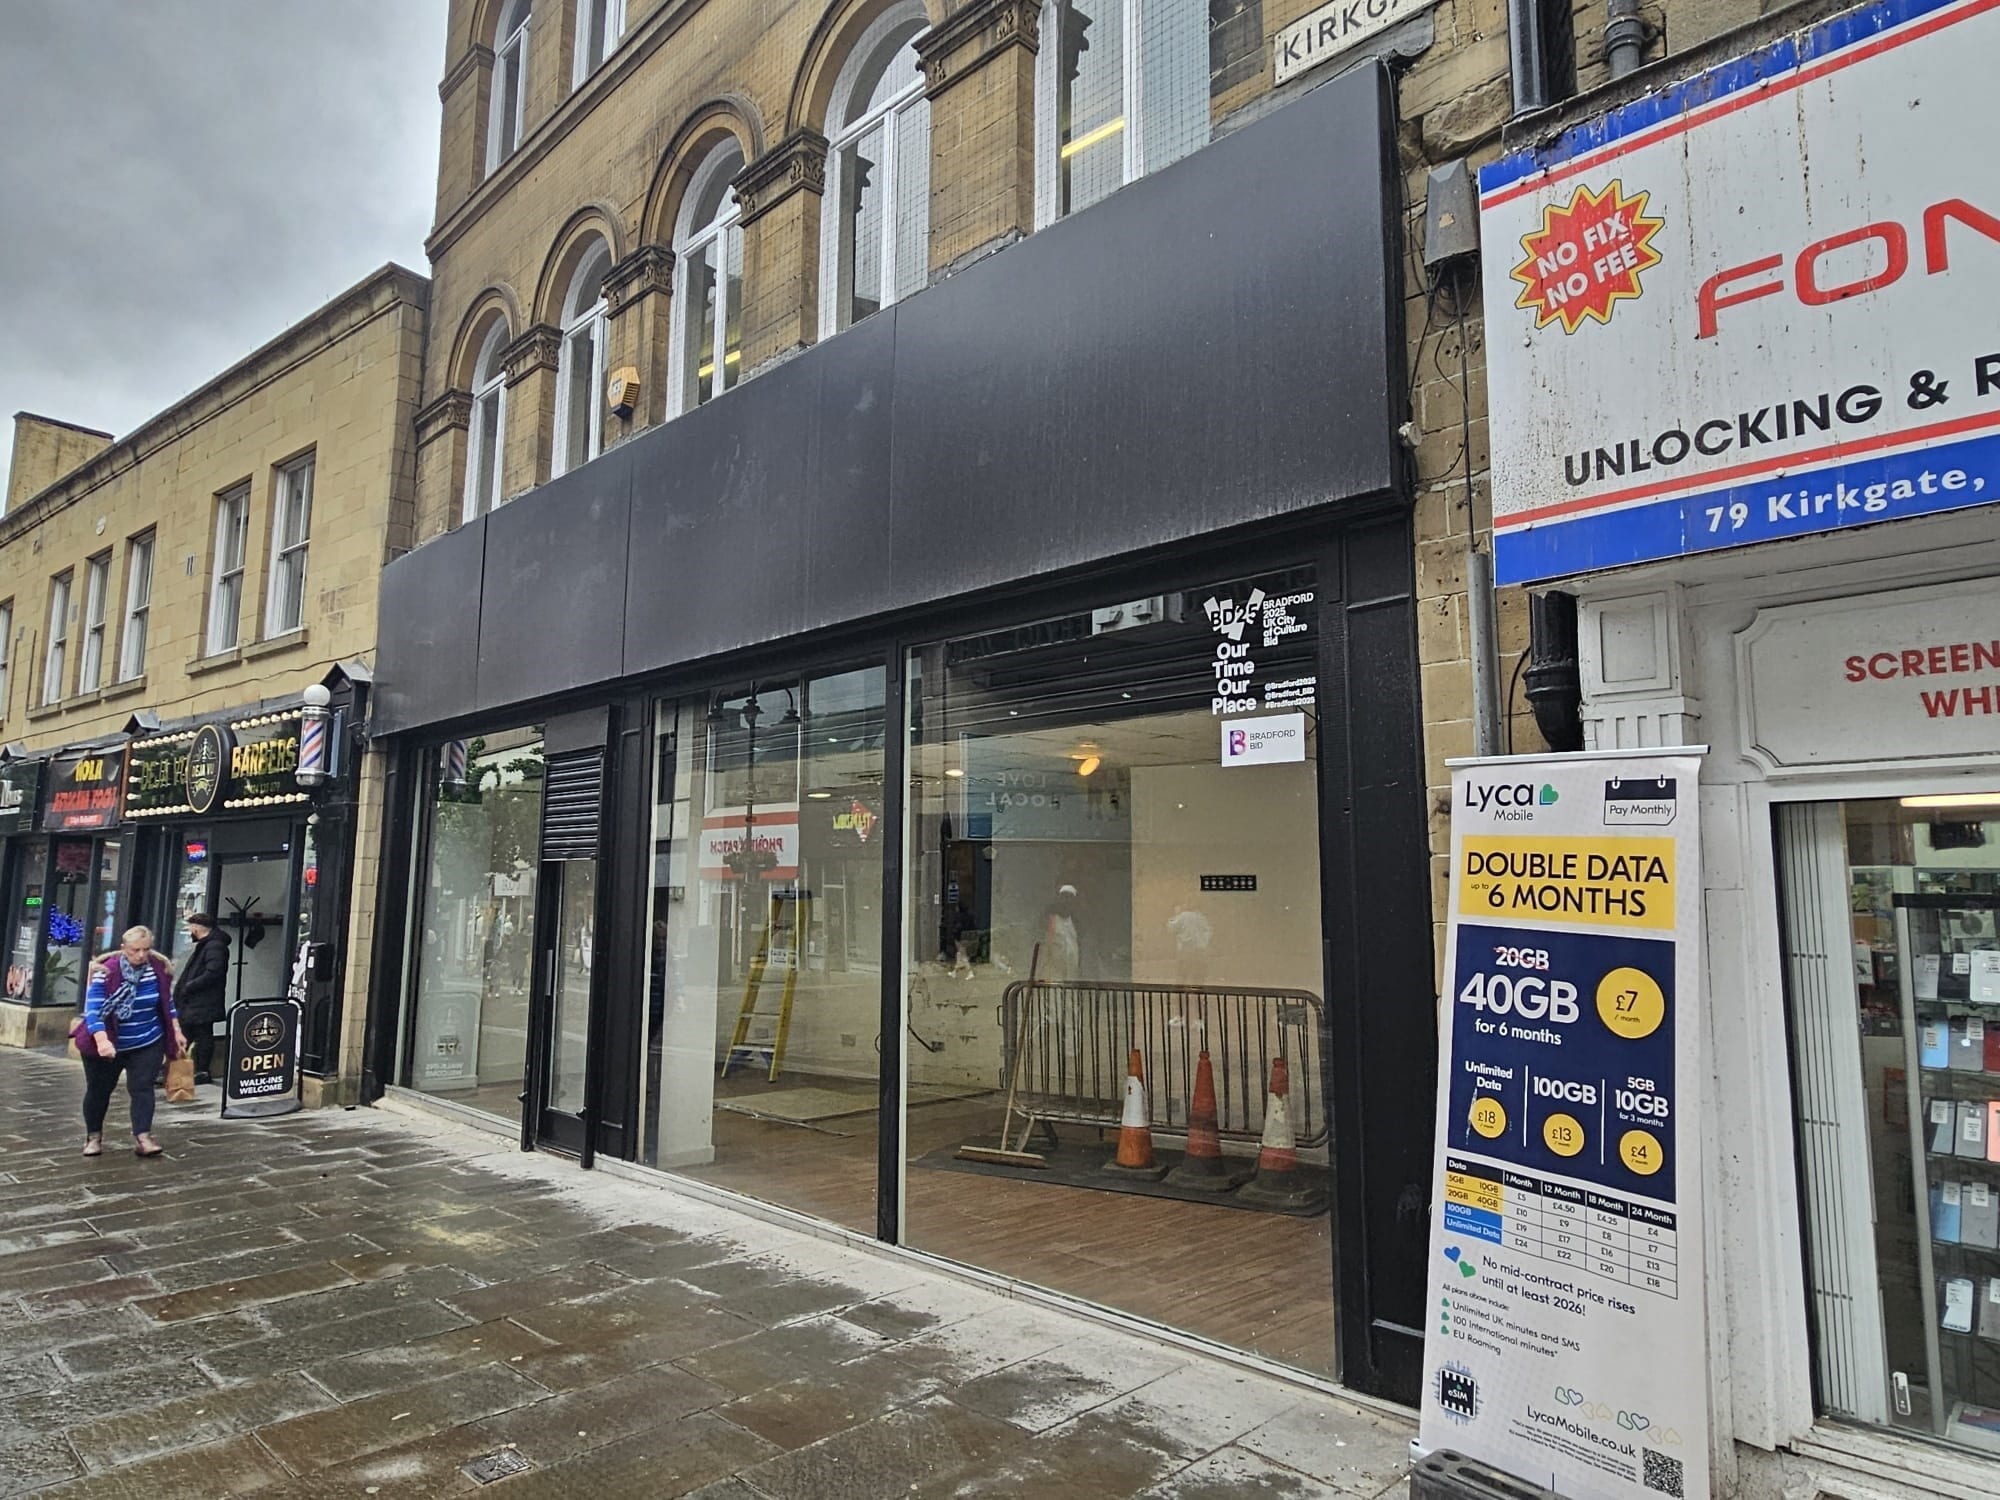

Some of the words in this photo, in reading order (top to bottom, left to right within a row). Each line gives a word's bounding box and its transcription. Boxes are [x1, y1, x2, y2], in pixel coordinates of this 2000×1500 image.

[1284, 0, 1398, 67] KIRKG
[1537, 241, 1578, 279] NO
[1583, 211, 1628, 252] FIX
[1546, 272, 1588, 310] NO
[1593, 242, 1638, 284] FEE
[1564, 385, 1883, 486] UNLOCKING
[1907, 369, 1949, 410] &
[1705, 503, 1748, 533] 79
[1768, 469, 1985, 522] Kirkgate,
[1263, 592, 1314, 610] BRADFORD
[1263, 607, 1286, 619] 2025
[1263, 618, 1276, 628] UK
[1277, 616, 1296, 626] City
[1263, 627, 1272, 637] of
[1273, 623, 1307, 636] Culture
[1263, 636, 1278, 647] Bid
[1217, 642, 1250, 659] Our
[1846, 640, 2000, 682] SCREEN
[1212, 660, 1255, 678] Time
[1217, 679, 1250, 695] Our
[1212, 696, 1257, 715] Place
[1250, 729, 1296, 741] BRADFORD
[1250, 741, 1263, 750] BID
[231, 737, 297, 779] BARBERS
[1466, 781, 1534, 812] Lyca
[1494, 809, 1534, 821] Mobile
[1610, 805, 1628, 816] Pay
[1630, 804, 1672, 817] Monthly
[1467, 852, 1578, 879] DOUBLE
[1587, 854, 1669, 884] DATA
[1488, 884, 1505, 907] 6
[1512, 884, 1646, 917] MONTHS
[1495, 946, 1550, 970] 20GB
[1460, 973, 1580, 1024] 40GB
[1616, 990, 1638, 1012] £7
[1475, 1018, 1496, 1034] for
[1499, 1022, 1508, 1036] 6
[1512, 1029, 1562, 1045] months
[241, 1053, 285, 1072] OPEN
[1465, 1060, 1513, 1079] Unlimited
[239, 1076, 283, 1087] WALK-INS
[1477, 1076, 1502, 1091] Data
[1627, 1077, 1655, 1092] 5GB
[239, 1084, 283, 1095] WELCOME
[1533, 1076, 1597, 1105] 100GB
[1615, 1089, 1669, 1118] 10GB
[1477, 1111, 1496, 1124] £18
[1619, 1112, 1629, 1120] for
[1637, 1117, 1664, 1127] months
[1552, 1127, 1572, 1142] £13
[1631, 1145, 1647, 1159] £4
[1449, 1159, 1467, 1170] Data
[1449, 1175, 1464, 1184] 5GB
[1480, 1182, 1499, 1193] 10GB
[1510, 1174, 1533, 1188] Month
[1448, 1190, 1468, 1200] 20GB
[1477, 1196, 1498, 1207] 40GB
[1517, 1193, 1526, 1201] £5
[1544, 1184, 1552, 1193] 12
[1554, 1186, 1581, 1200] Month
[1447, 1203, 1472, 1216] 100GB
[1552, 1202, 1576, 1213] £4.50
[1589, 1195, 1597, 1204] 18
[1598, 1198, 1624, 1212] Month
[1516, 1208, 1528, 1217] £10
[1597, 1213, 1618, 1226] £4.25
[1632, 1207, 1642, 1216] 24
[1644, 1210, 1673, 1224] Month
[1446, 1218, 1482, 1233] Unlimited
[1483, 1226, 1500, 1239] Data
[1516, 1223, 1527, 1232] £19
[1560, 1219, 1570, 1228] £9
[1558, 1235, 1571, 1244] £17
[1648, 1227, 1658, 1237] £4
[1515, 1238, 1528, 1248] £24
[1649, 1245, 1658, 1254] £7
[1557, 1250, 1572, 1260] £22
[1601, 1247, 1614, 1258] £16
[1600, 1263, 1614, 1274] £20
[1647, 1260, 1660, 1271] £13
[1482, 1256, 1497, 1269] No
[1500, 1264, 1573, 1293] mid-contract
[1577, 1287, 1604, 1305] price
[1608, 1297, 1636, 1315] rises
[1647, 1277, 1660, 1288] £18
[1482, 1275, 1504, 1290] until
[1506, 1284, 1519, 1295] at
[1521, 1286, 1550, 1305] least
[1553, 1296, 1586, 1316] 2026!
[1452, 1301, 1490, 1320] Unlimited
[1492, 1314, 1504, 1326] UK
[1506, 1320, 1538, 1338] minutes
[1541, 1332, 1559, 1344] and
[1561, 1337, 1581, 1352] SMS
[1453, 1315, 1467, 1327] 100
[1469, 1322, 1518, 1345] International
[1453, 1330, 1465, 1340] EU
[1467, 1334, 1501, 1356] Roaming
[1448, 1389, 1468, 1402] eSIM
[1527, 1405, 1637, 1458] LycaMobile.co.uk
